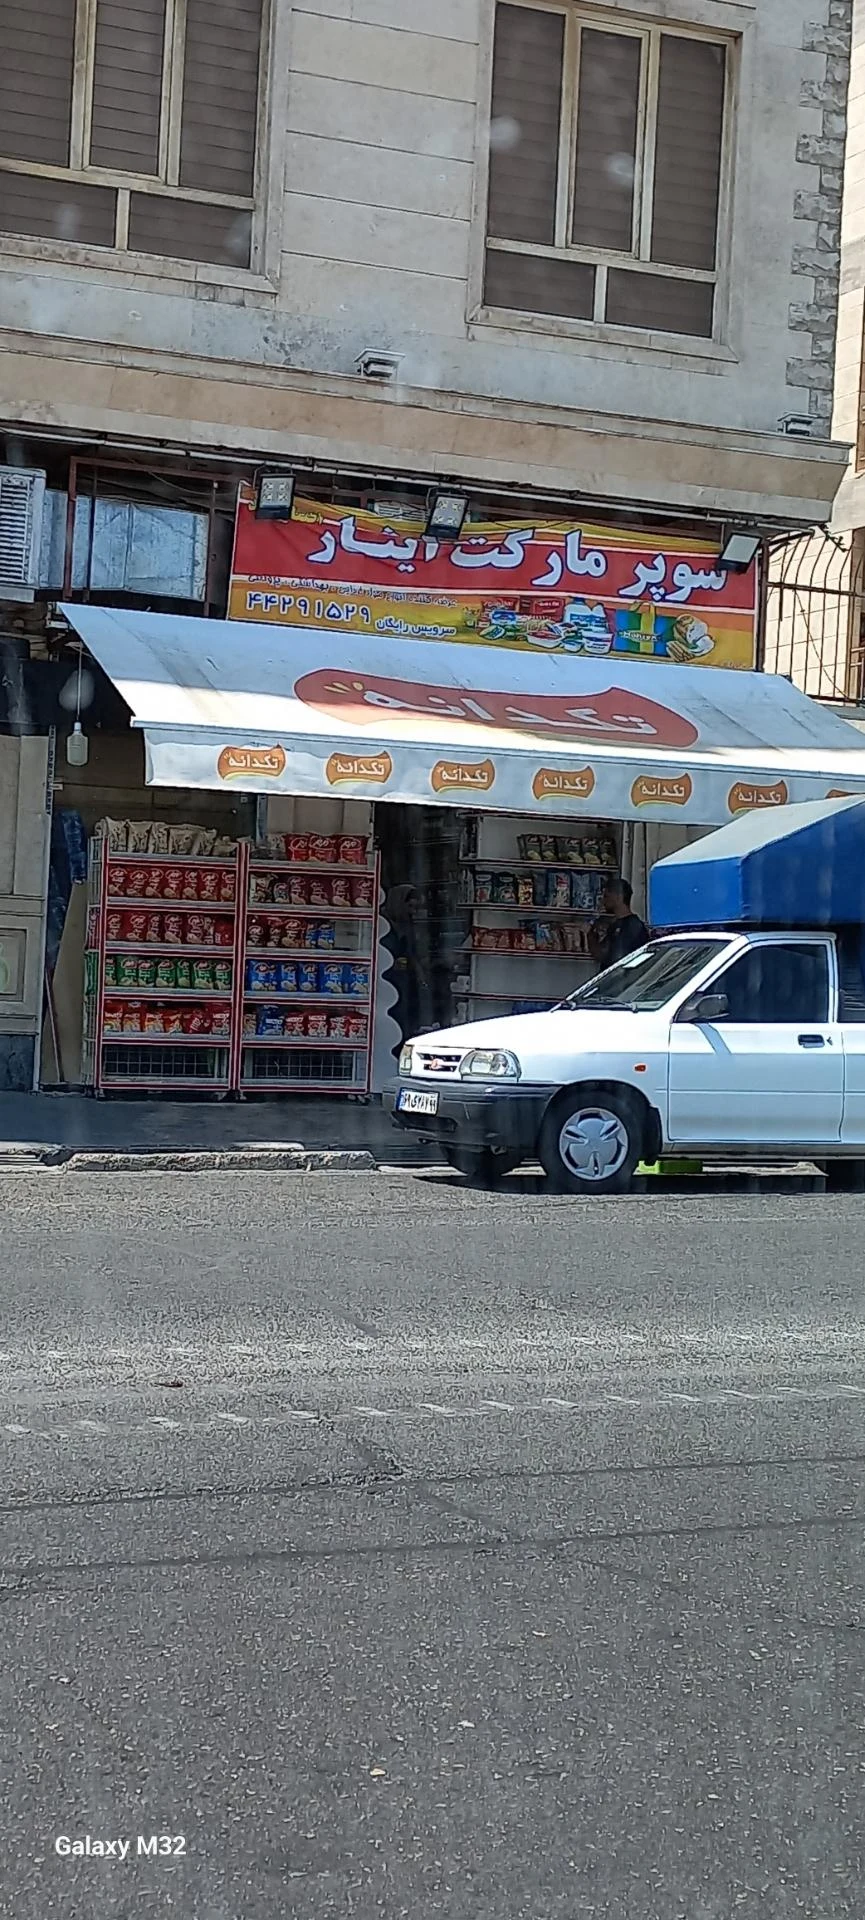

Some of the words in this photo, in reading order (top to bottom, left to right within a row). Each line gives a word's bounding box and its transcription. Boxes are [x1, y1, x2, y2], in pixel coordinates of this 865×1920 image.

[450, 528, 608, 587] مارکت
[618, 551, 728, 602] سوپر
[247, 591, 371, 623] ۴۴۲۹۱۵۲۹
[376, 616, 409, 633] رایگان
[411, 624, 457, 636] سرویس
[363, 689, 658, 735] تکدانه
[227, 753, 279, 769] تکدانه
[336, 761, 385, 776] تکدانه
[441, 767, 488, 783] تکدانه
[542, 775, 588, 791] تکدانه
[641, 782, 685, 798] تکدانه
[737, 789, 782, 805] تکدانه
